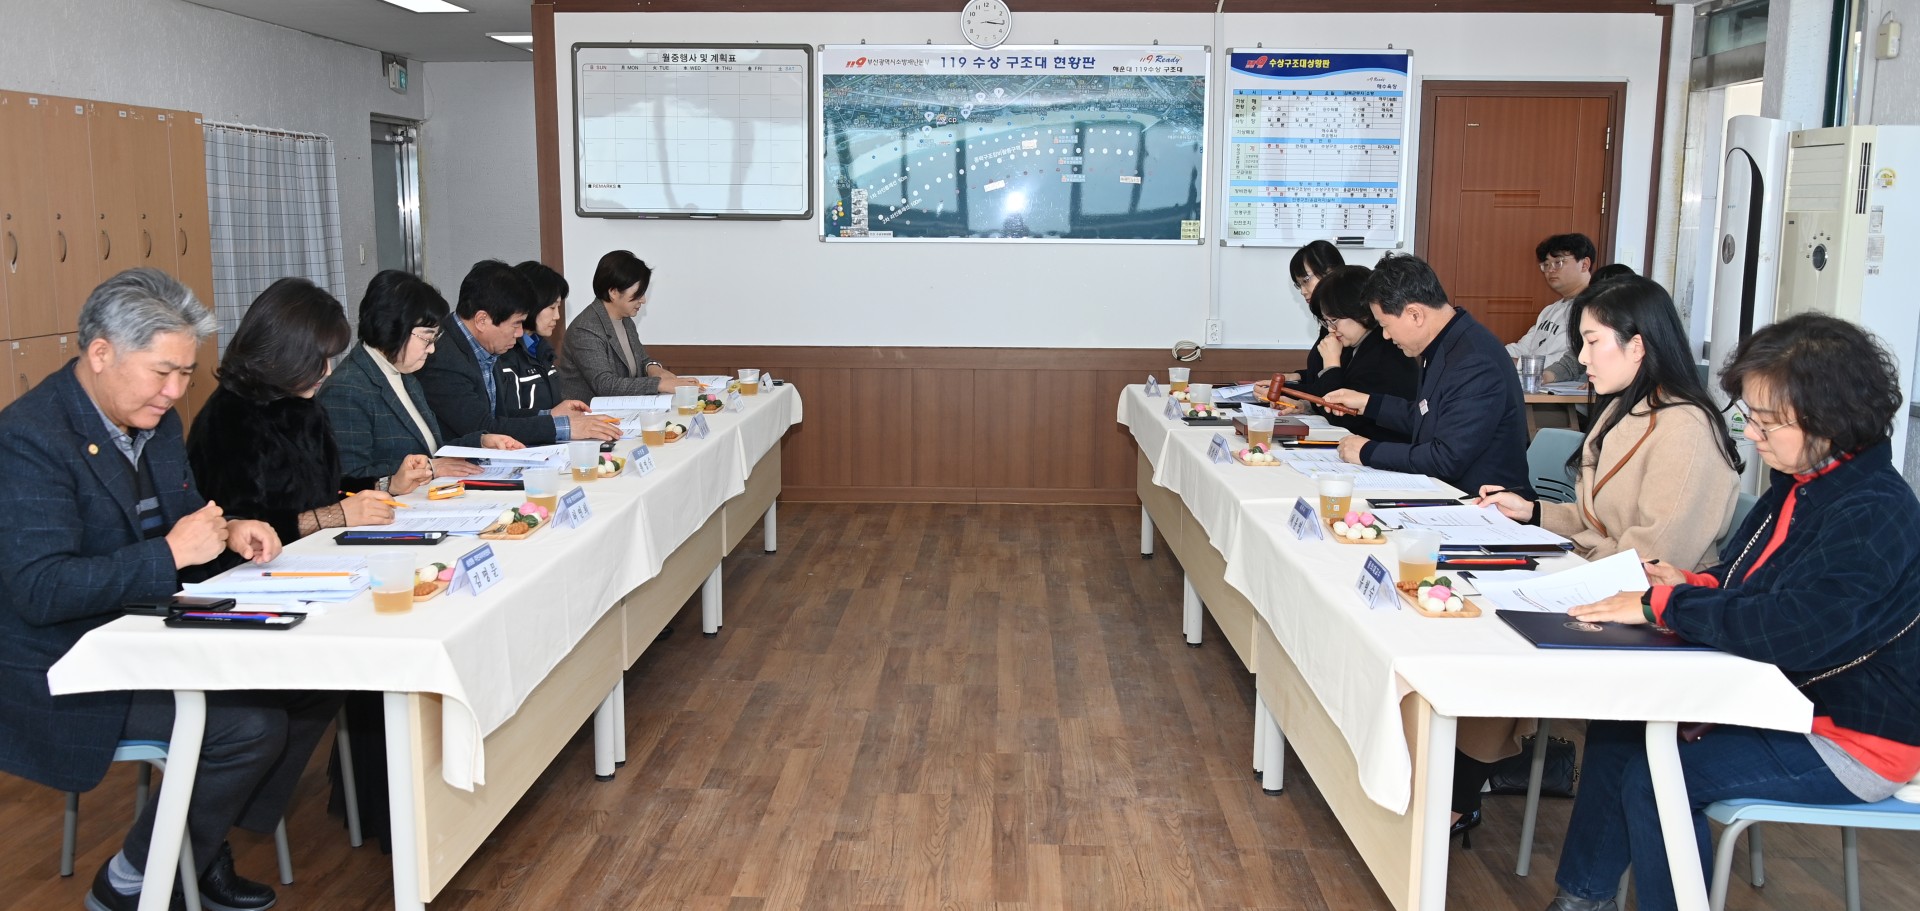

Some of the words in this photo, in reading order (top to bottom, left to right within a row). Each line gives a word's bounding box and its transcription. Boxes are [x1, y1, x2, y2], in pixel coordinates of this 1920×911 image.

[661, 53, 697, 63] 월중행사
[700, 53, 708, 63] 및
[710, 53, 737, 63] 계획표
[940, 56, 967, 68] 119
[973, 56, 1001, 69] 수상
[1006, 56, 1048, 69] 구조대
[1053, 56, 1096, 69] 현황판
[1155, 55, 1180, 64] Ready
[1269, 58, 1330, 69] 수상구조대상황판
